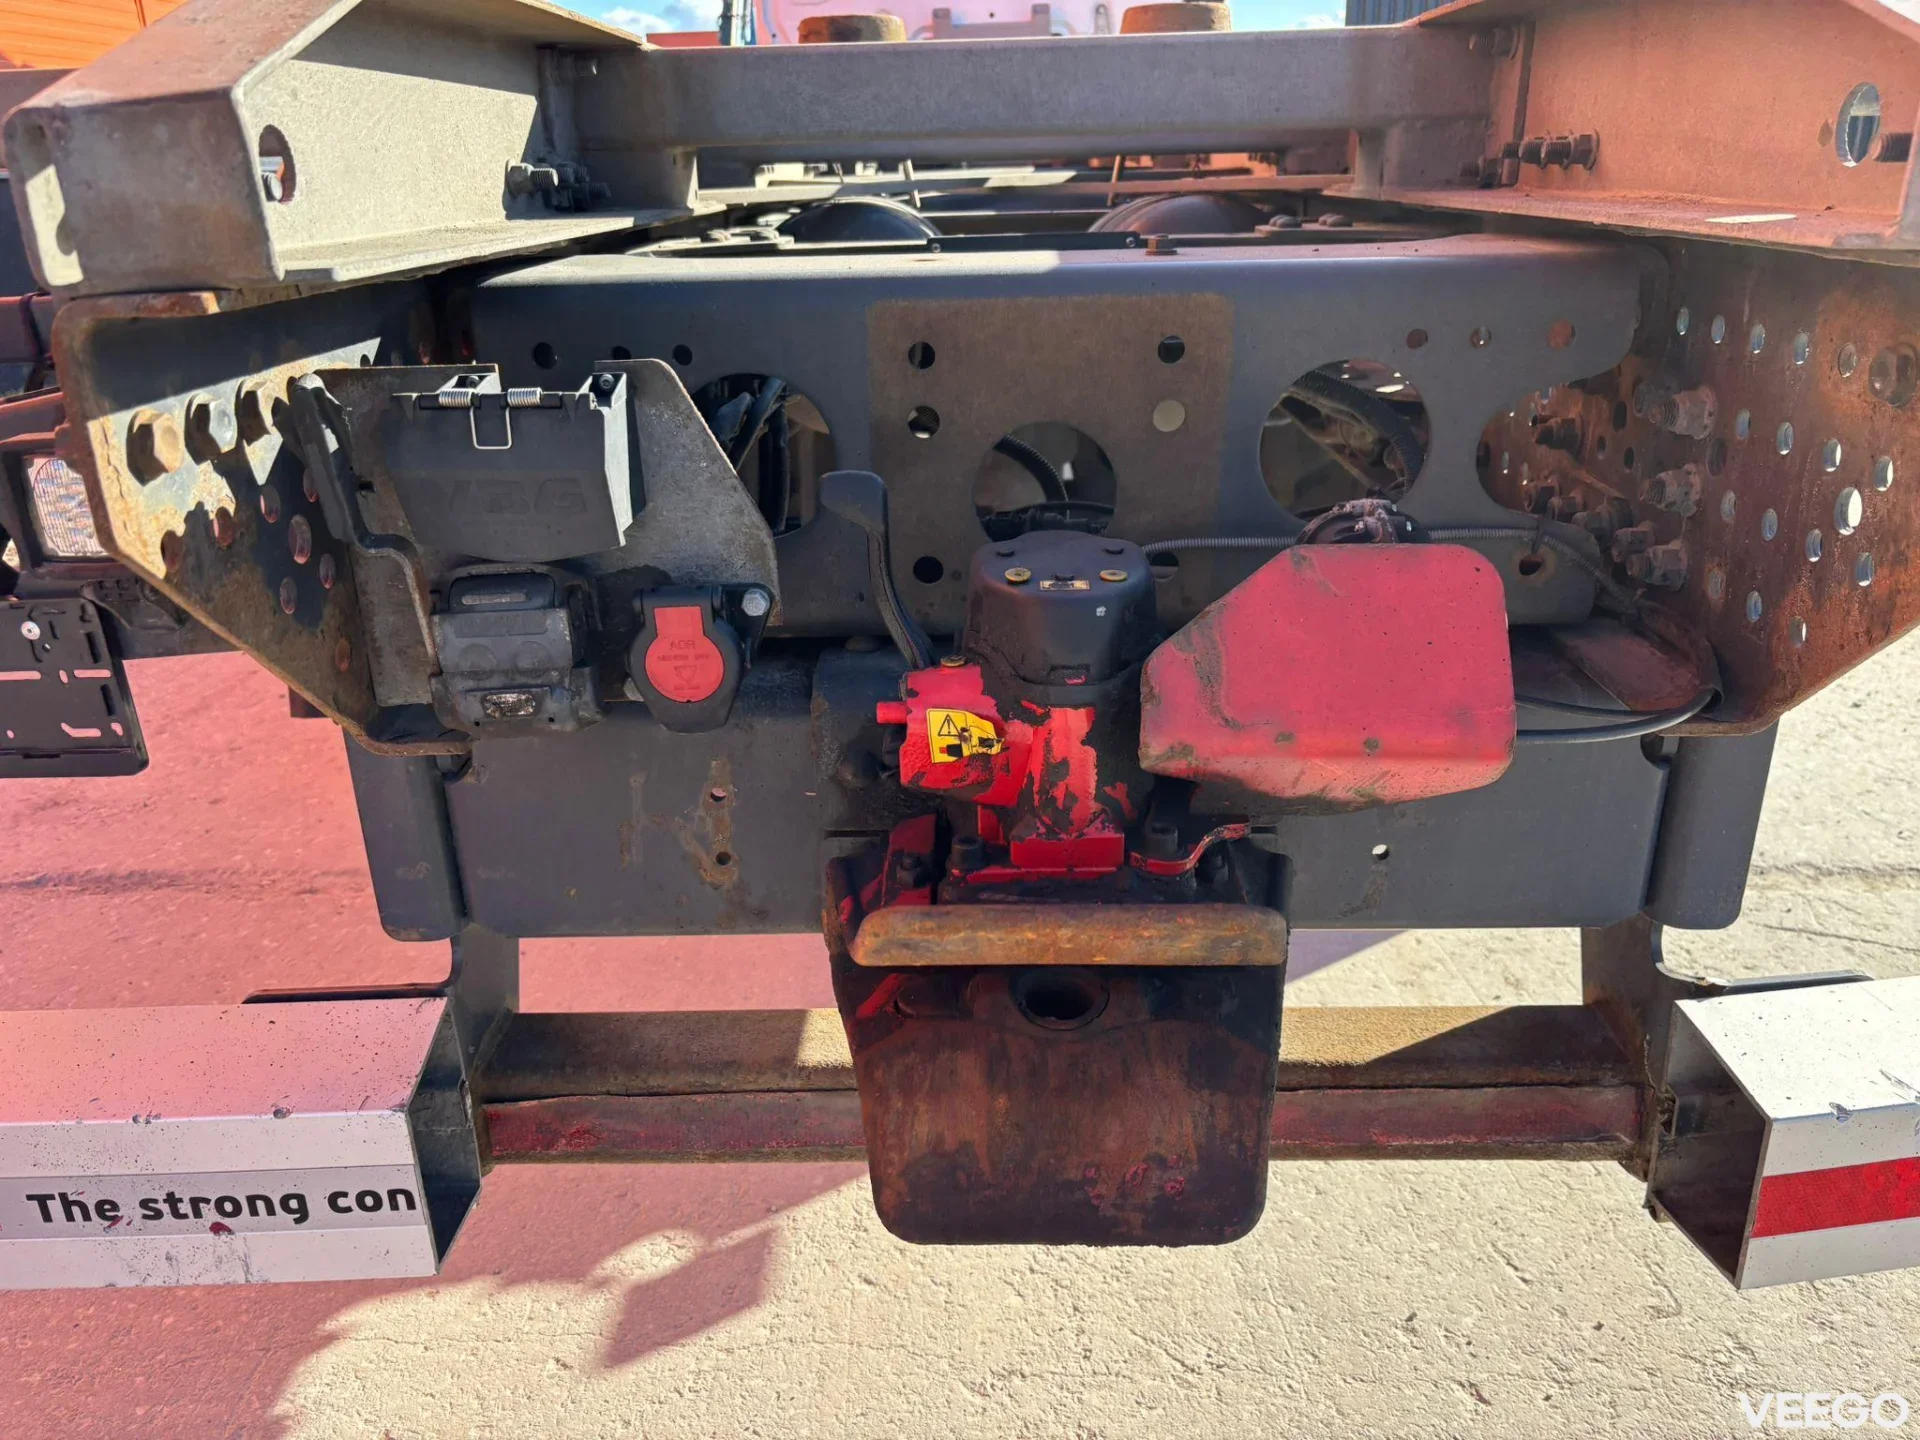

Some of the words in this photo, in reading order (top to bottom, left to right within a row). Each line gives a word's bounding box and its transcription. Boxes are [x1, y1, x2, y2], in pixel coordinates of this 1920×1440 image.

[26, 1191, 120, 1224] The
[139, 1190, 310, 1226] strong
[328, 1187, 417, 1215] con
